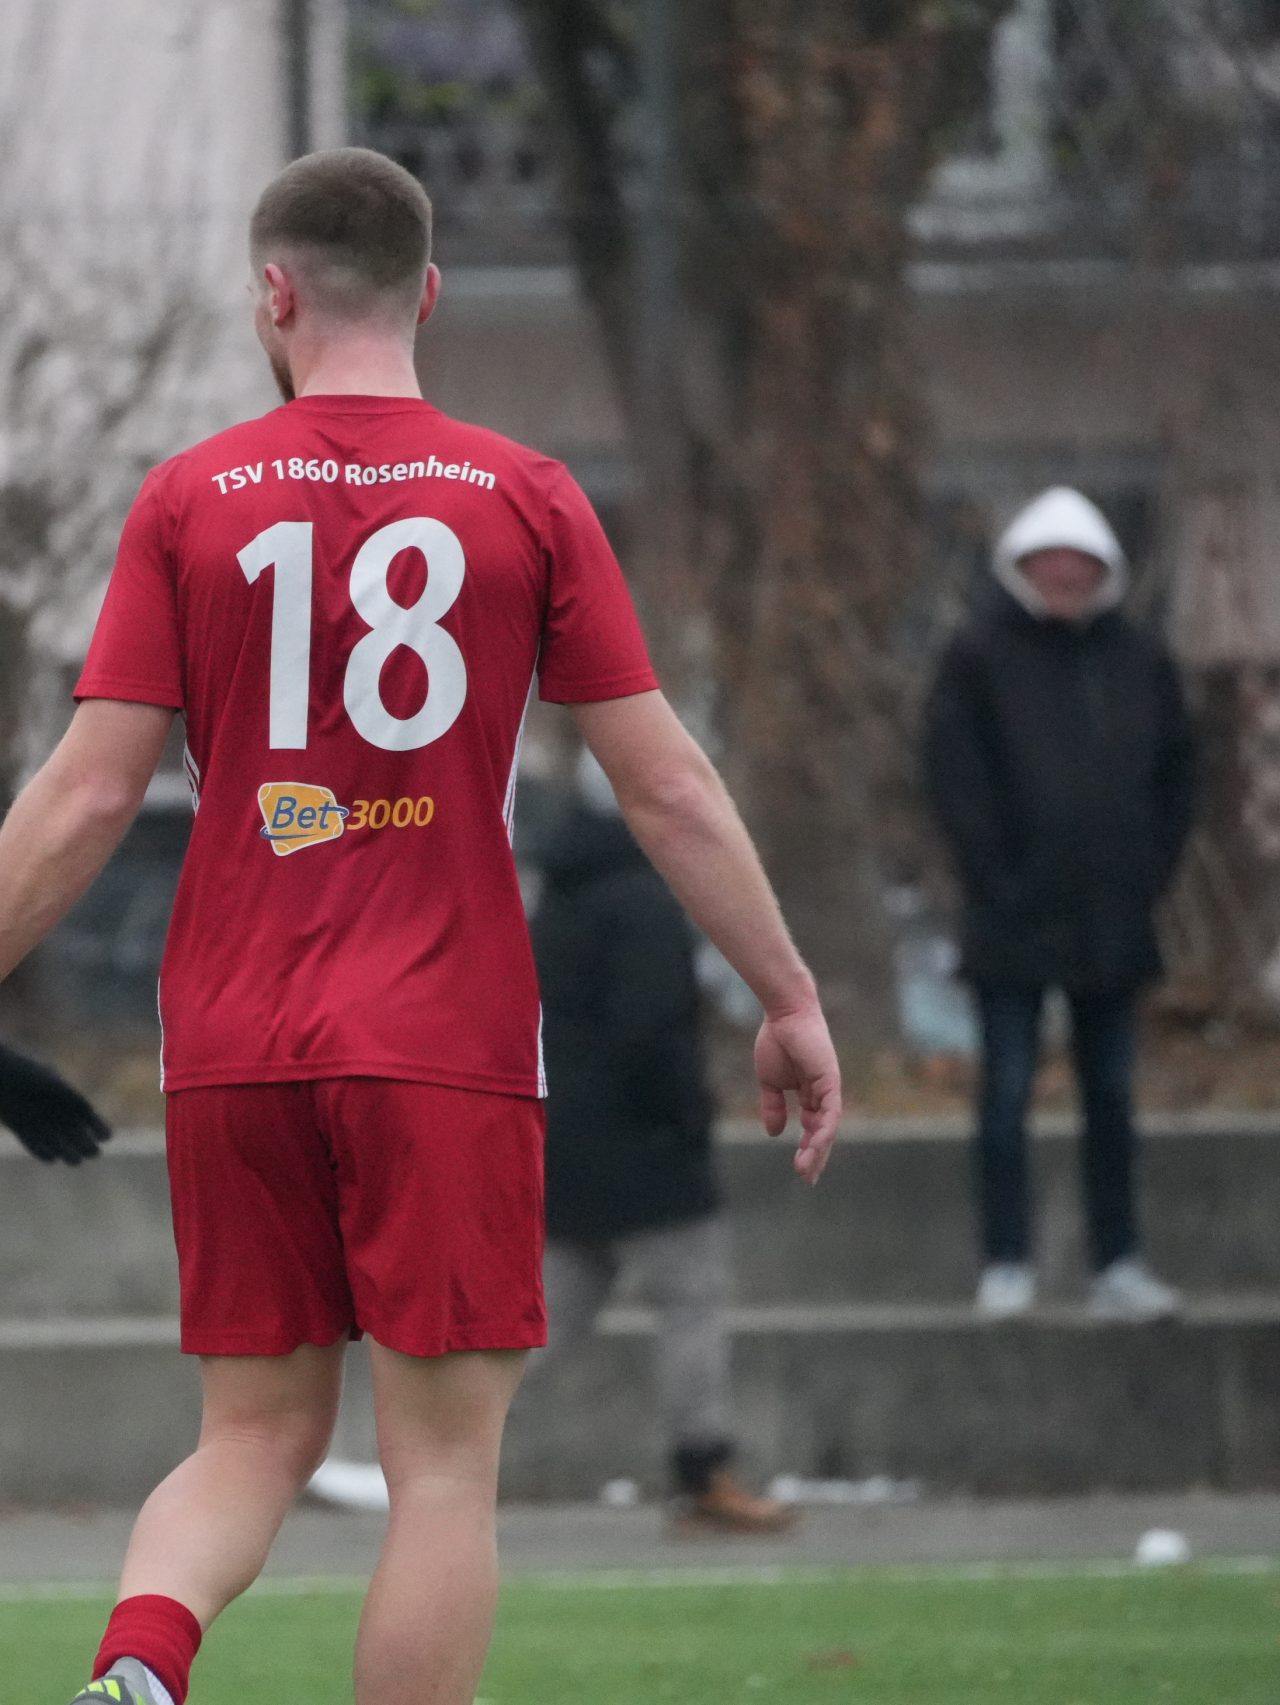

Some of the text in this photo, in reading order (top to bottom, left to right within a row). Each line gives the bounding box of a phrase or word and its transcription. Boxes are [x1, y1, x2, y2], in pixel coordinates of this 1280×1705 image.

[211, 455, 496, 495] TSV 1860 Rosenheim
[235, 516, 468, 752] 18
